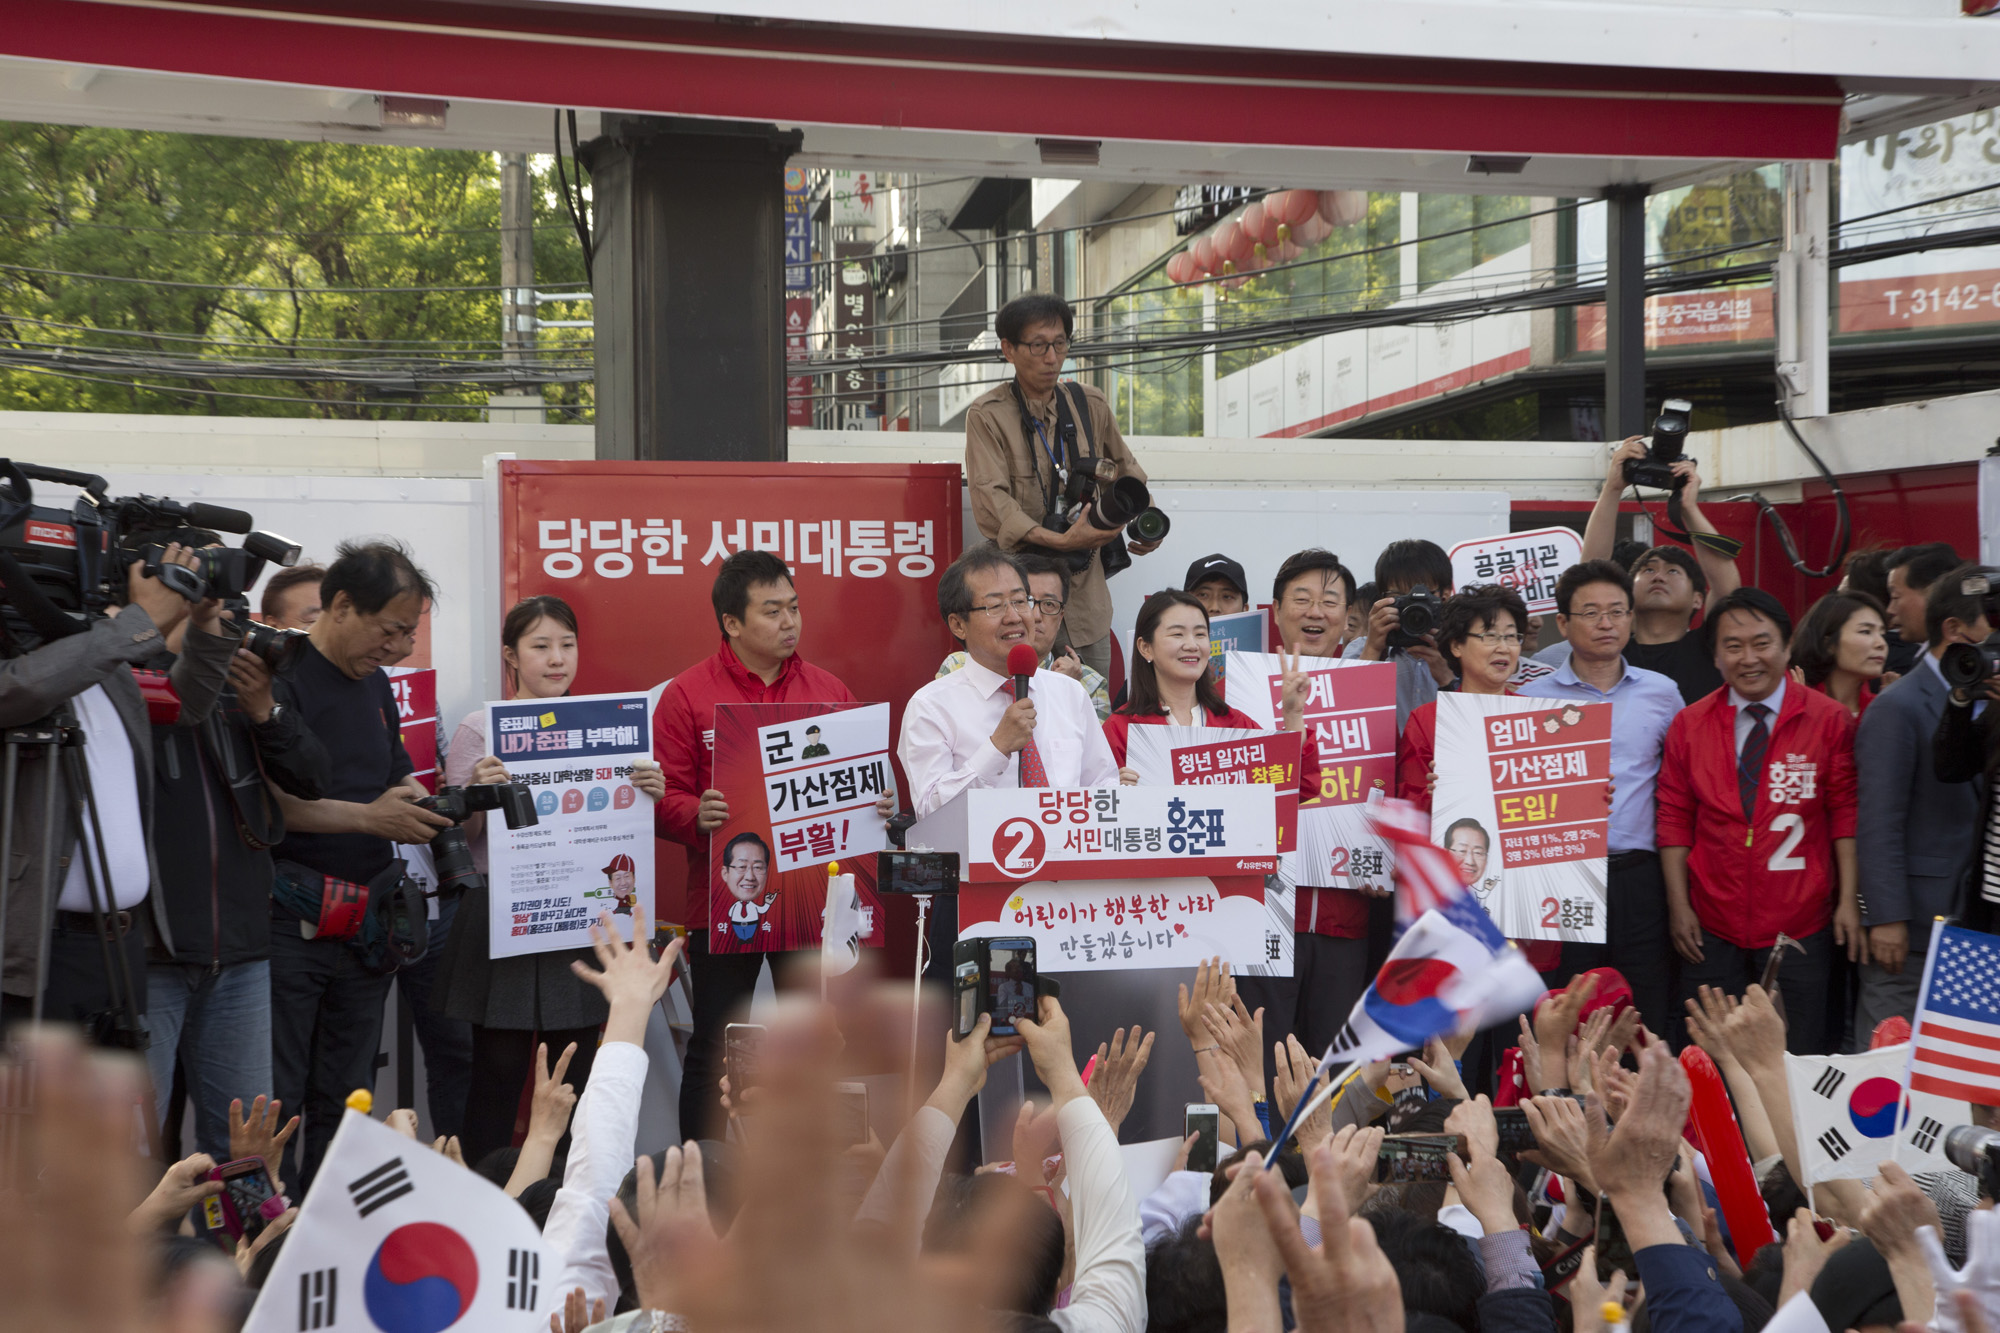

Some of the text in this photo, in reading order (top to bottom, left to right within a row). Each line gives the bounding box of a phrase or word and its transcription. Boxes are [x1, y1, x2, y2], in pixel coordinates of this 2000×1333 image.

[30, 526, 62, 540] MBC
[538, 518, 935, 579] 당당한 서민대통령
[1474, 544, 1560, 579] 공공기관
[1273, 673, 1336, 709] 계
[499, 716, 539, 732] 준표씨!
[501, 725, 639, 754] 내가 준표를 부탁해!
[1490, 716, 1537, 747] 엄마
[765, 730, 794, 766] 군
[1178, 743, 1266, 774] 청년 일자리
[553, 768, 595, 784] 대학생활
[595, 767, 612, 780] 5대
[1251, 763, 1293, 785] 창출!
[1493, 749, 1588, 785] 가산점제
[1768, 760, 1817, 804] 홍준표
[770, 760, 886, 813] 가산점제
[1038, 789, 1120, 825] 당당한
[1500, 793, 1558, 823] 도입!
[779, 819, 851, 863] 부활!
[1063, 826, 1162, 854] 서민대통령
[1166, 797, 1226, 855] 홍준표
[1504, 836, 1523, 849] 자녀
[1524, 834, 1540, 847] 1명
[1541, 832, 1562, 844] 1%,
[1562, 830, 1579, 842] 2명
[1767, 813, 1806, 871] 2
[1003, 821, 1035, 869] 2
[1506, 843, 1586, 863] 3명 3% (상한 3%)
[1331, 846, 1350, 877] 2
[1351, 847, 1383, 879] 홍준표
[1014, 893, 1216, 930] 어린이가 행복한 나라
[1541, 896, 1560, 928] 2
[1561, 898, 1594, 930] 홍준표
[718, 921, 772, 935] 약 속
[1059, 929, 1175, 963] 만들겠습니다
